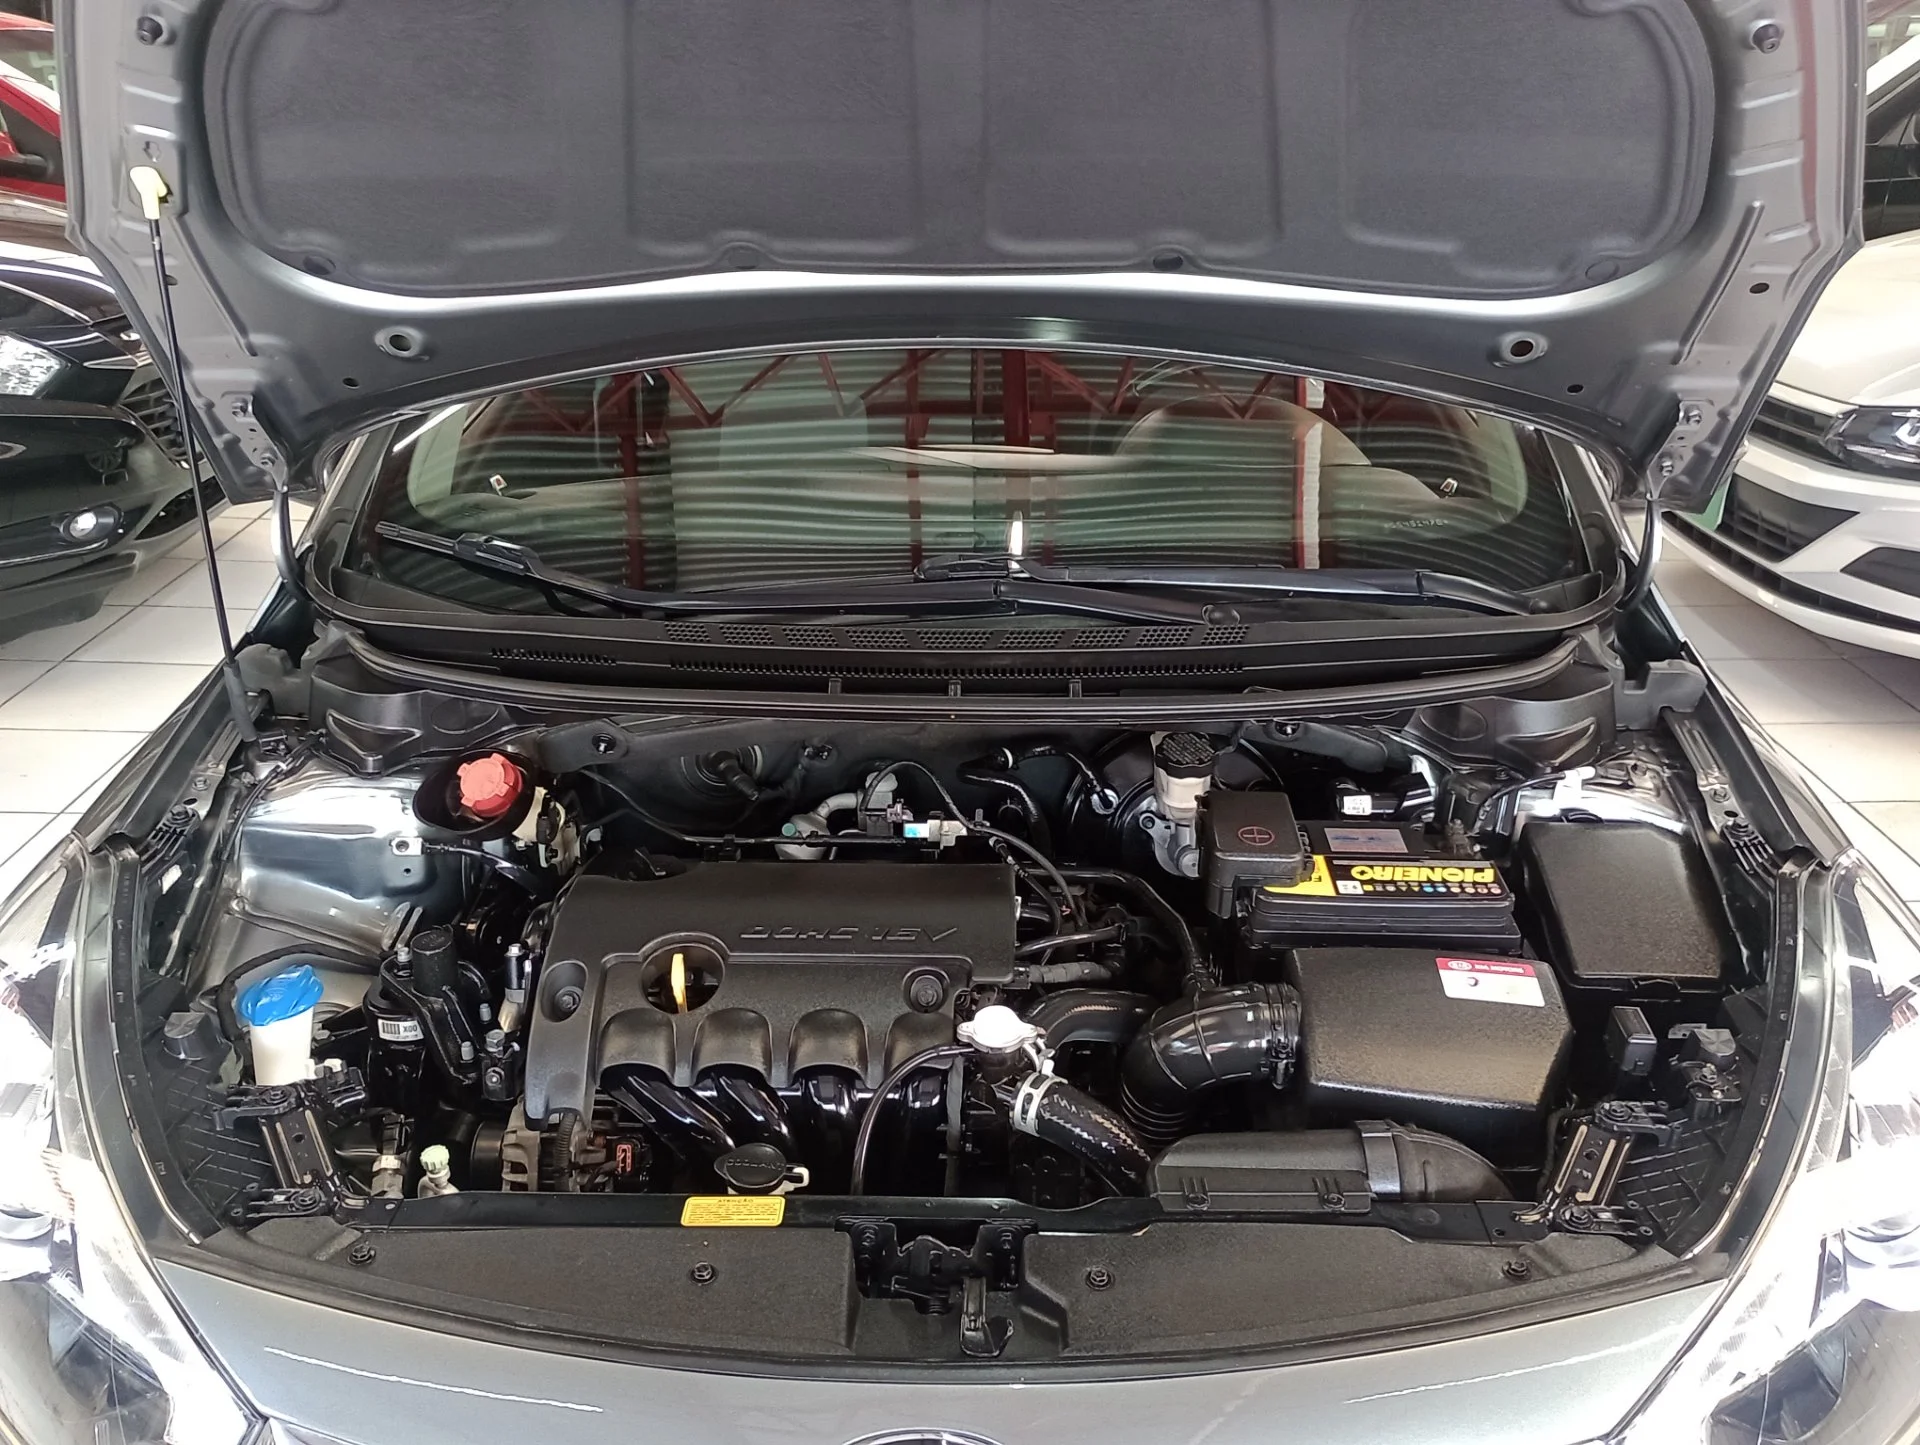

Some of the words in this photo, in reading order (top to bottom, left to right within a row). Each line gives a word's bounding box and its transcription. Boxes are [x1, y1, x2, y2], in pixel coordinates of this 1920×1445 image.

[1351, 865, 1495, 883] PIONEIRO
[740, 925, 859, 939] DOHC
[871, 926, 958, 941] 16V
